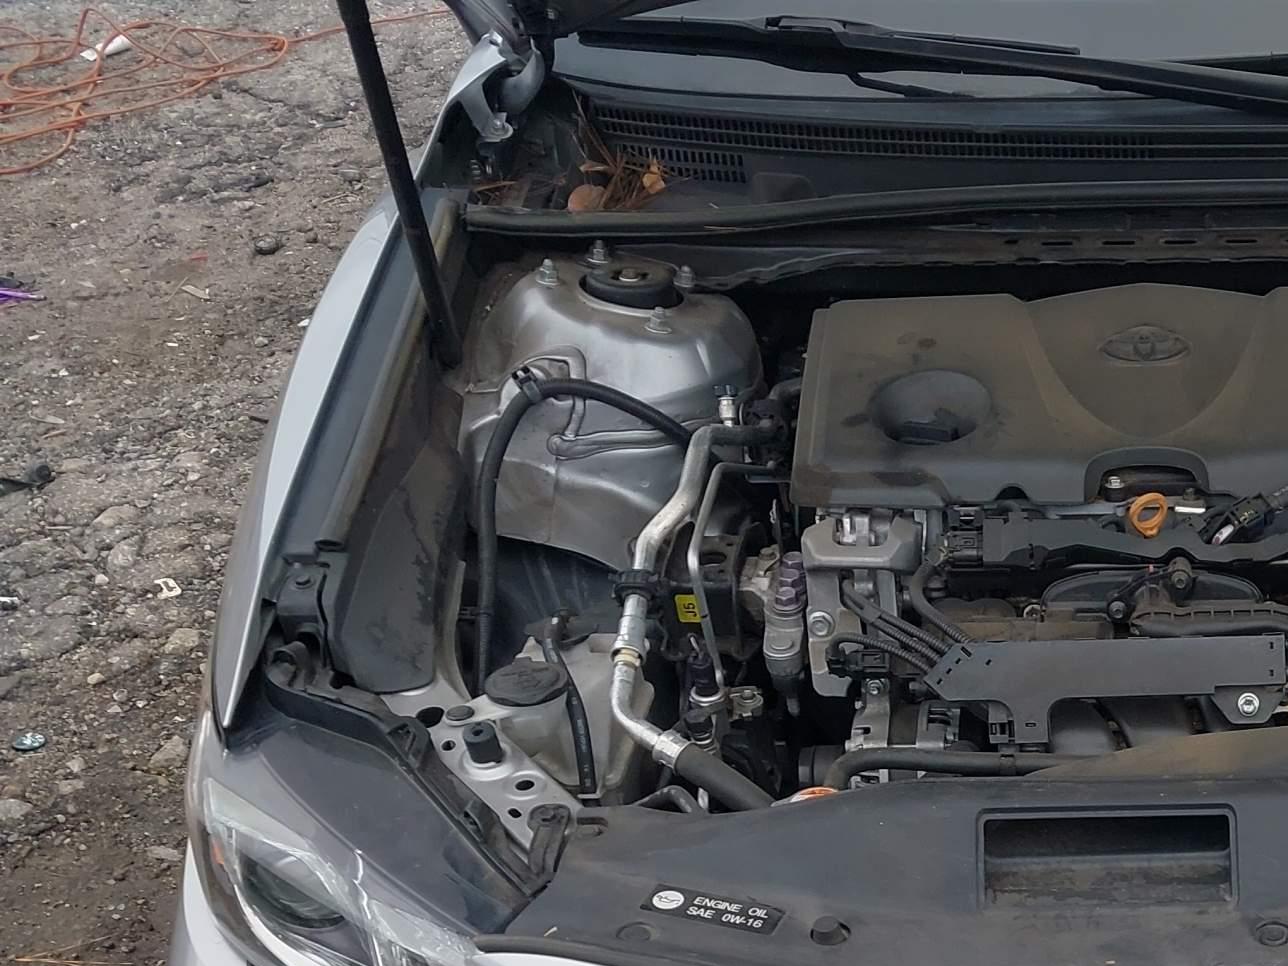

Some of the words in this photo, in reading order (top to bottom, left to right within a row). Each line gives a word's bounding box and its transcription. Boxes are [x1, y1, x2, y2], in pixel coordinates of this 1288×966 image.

[686, 906, 716, 919] SAE
[721, 913, 764, 928] 0W-16
[693, 896, 743, 913] ENGINE
[748, 907, 769, 919] OIL
